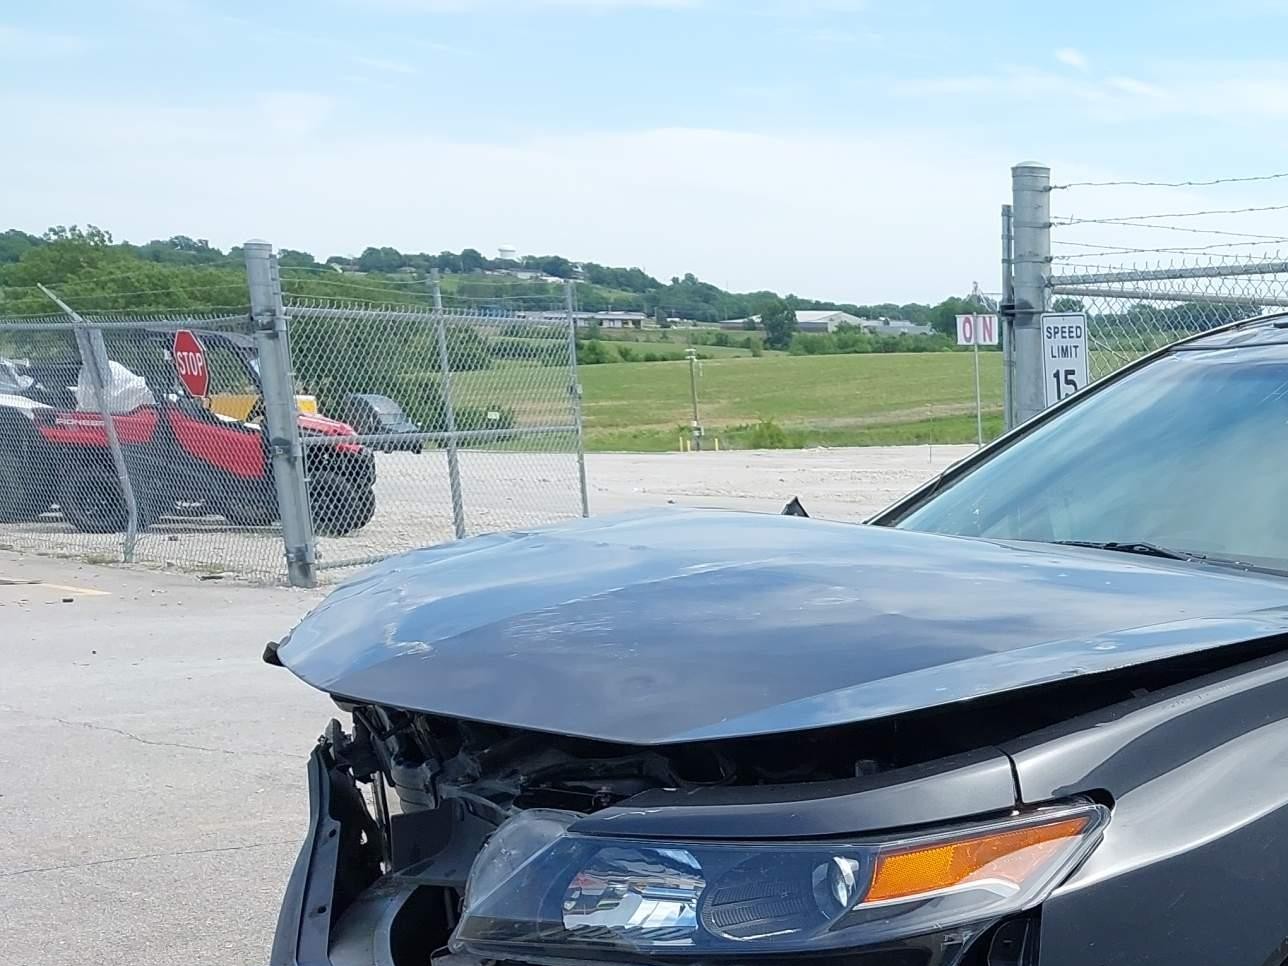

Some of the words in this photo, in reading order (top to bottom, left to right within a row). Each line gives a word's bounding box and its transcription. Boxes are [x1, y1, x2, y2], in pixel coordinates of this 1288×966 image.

[1046, 326, 1083, 339] SPEED
[1051, 345, 1079, 358] LIMIT
[177, 351, 203, 376] STOP
[1053, 369, 1078, 400] 15
